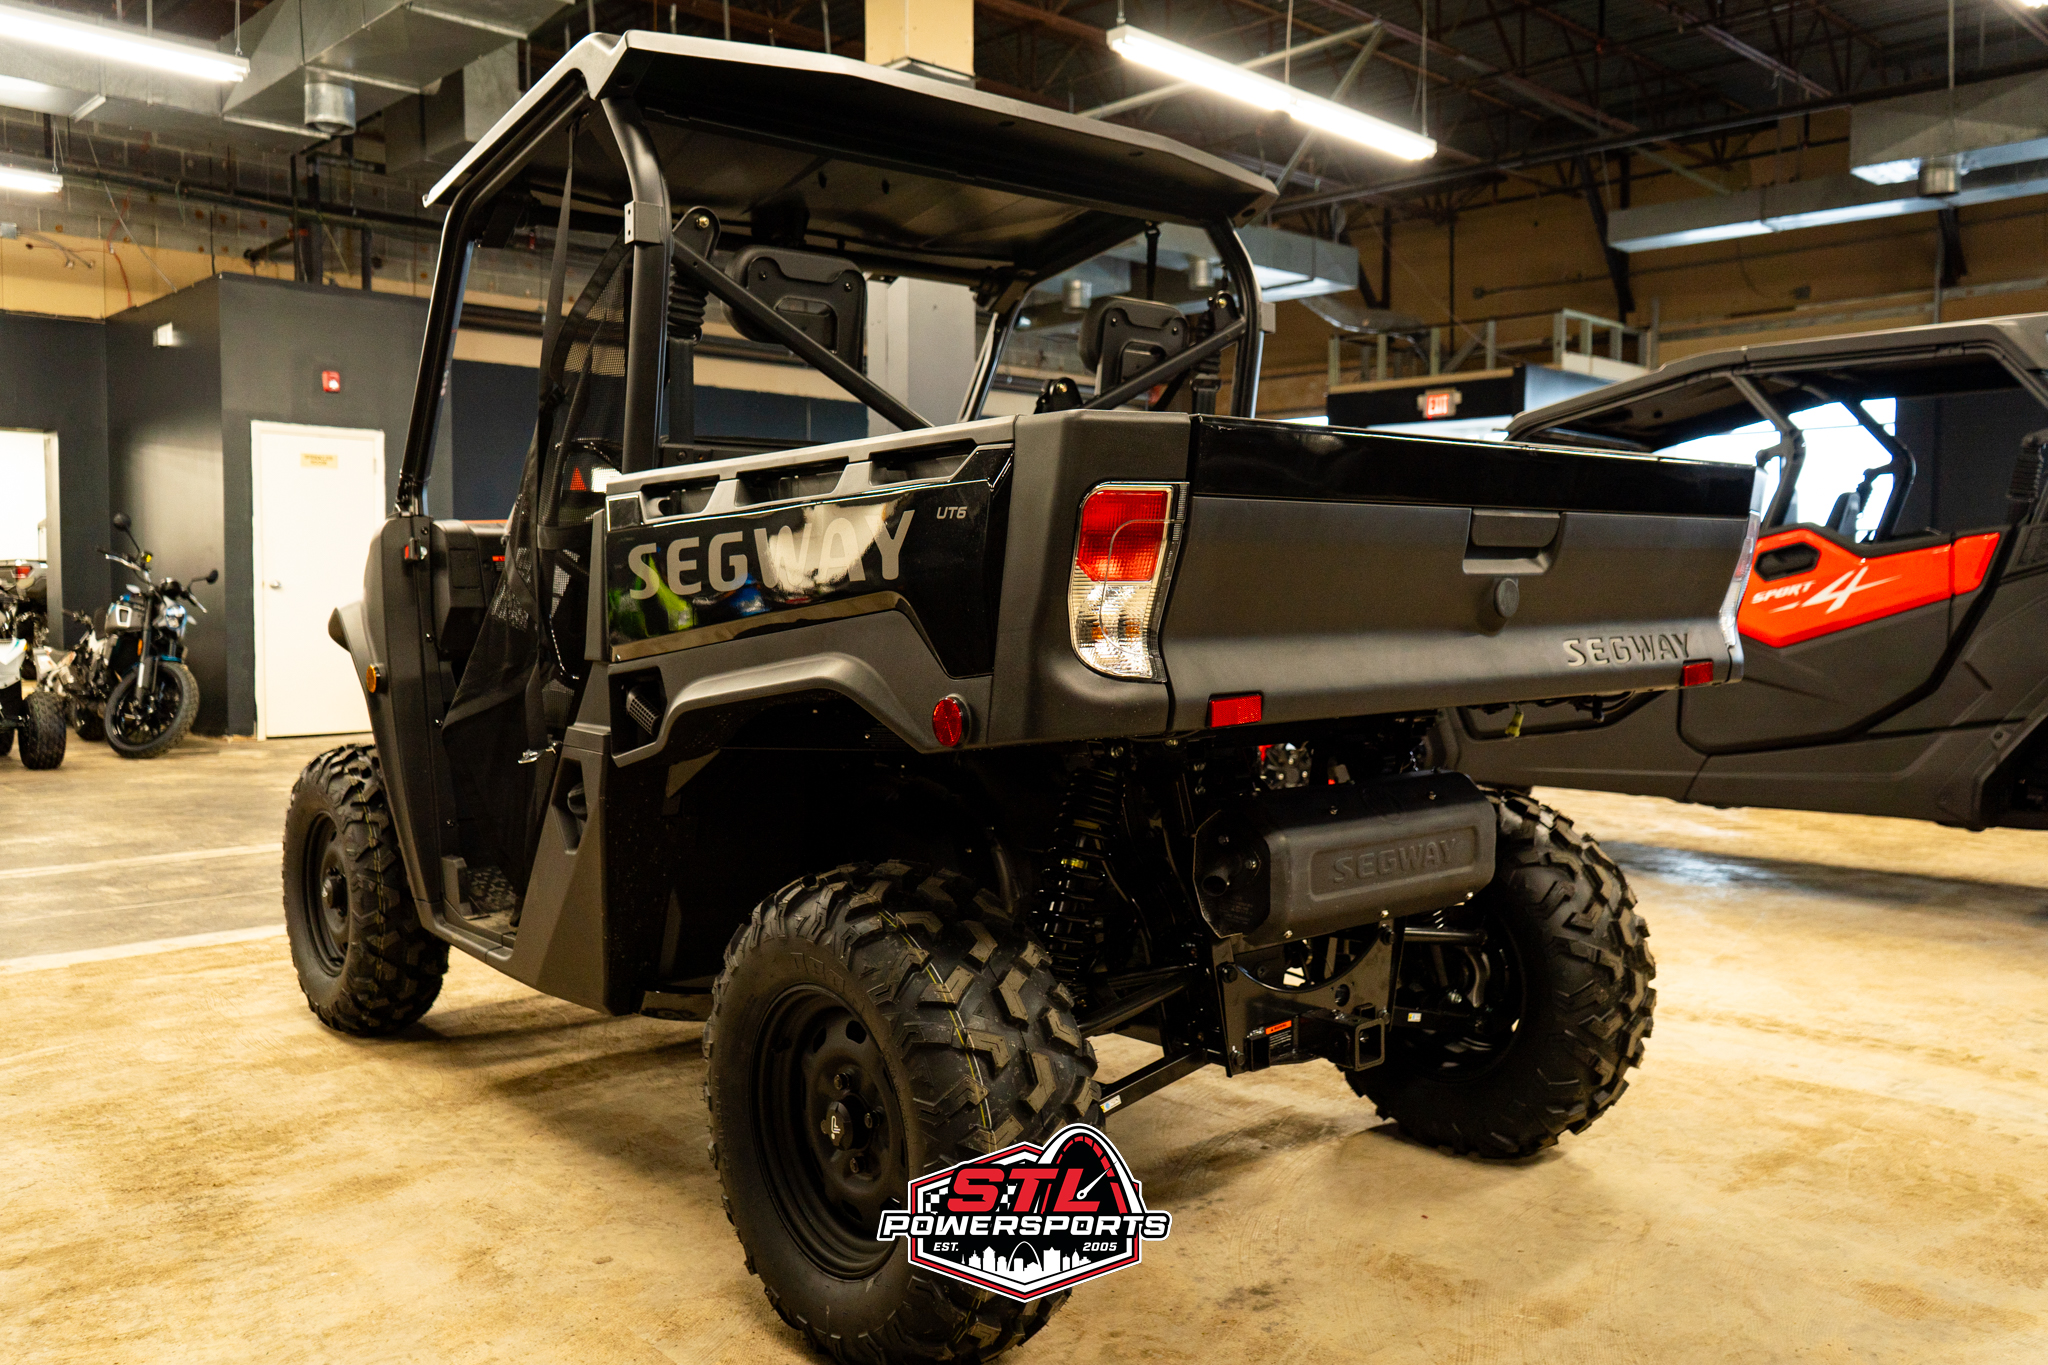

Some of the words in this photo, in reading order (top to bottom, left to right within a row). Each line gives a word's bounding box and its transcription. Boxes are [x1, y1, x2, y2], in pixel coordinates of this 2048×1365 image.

[936, 505, 967, 520] UT6
[628, 509, 915, 600] SEGWAY
[1751, 580, 1816, 605] SPORT
[1801, 565, 1901, 615] 4
[1562, 633, 1690, 667] SEGWAY
[1333, 838, 1456, 883] SEGWAY
